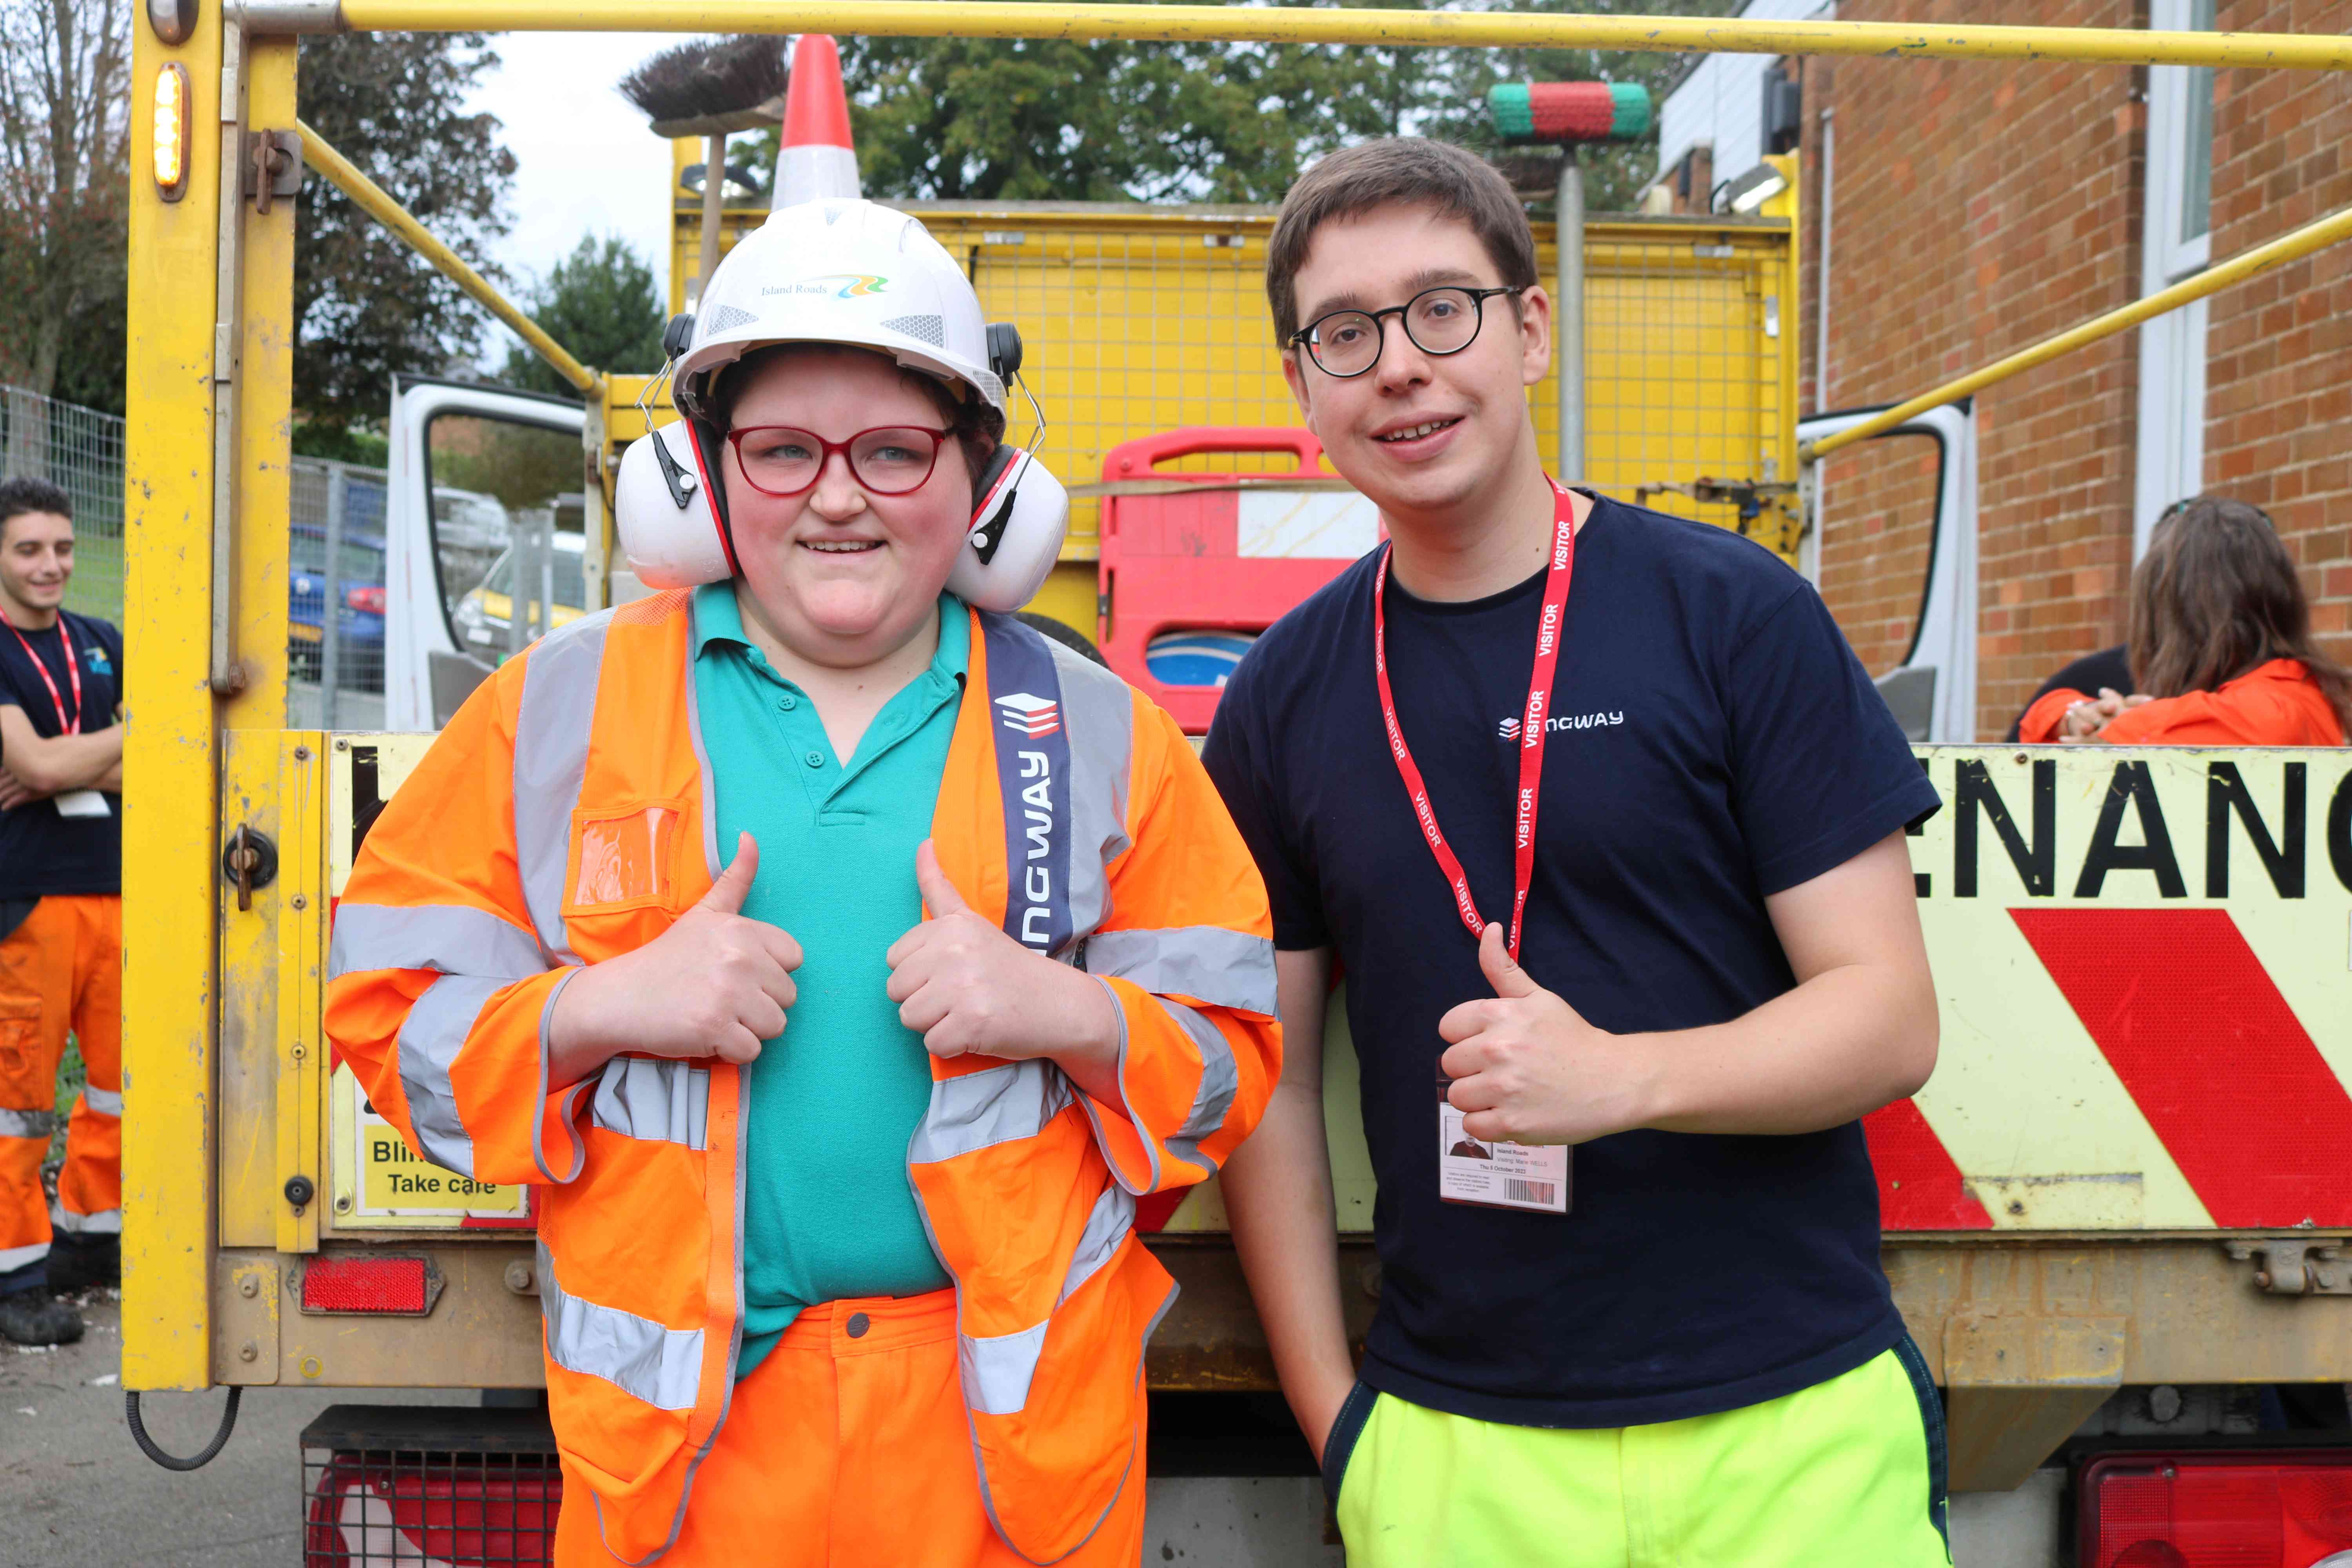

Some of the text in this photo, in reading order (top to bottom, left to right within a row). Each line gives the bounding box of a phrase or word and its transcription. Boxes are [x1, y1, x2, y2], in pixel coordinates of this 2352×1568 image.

[762, 284, 828, 296] Island Roads
[1553, 520, 1570, 571] VISITOR
[1539, 604, 1559, 657] VISITOR
[1385, 705, 1406, 762] VISITOR
[1524, 690, 1544, 749] VISITOR
[1545, 710, 1624, 732] NGWAY
[1416, 791, 1441, 848] VISITOR
[1518, 788, 1533, 849] VISITOR
[1018, 750, 1053, 957] NGWAY
[1456, 877, 1483, 933] VISITOR
[388, 1174, 496, 1194] Take care
